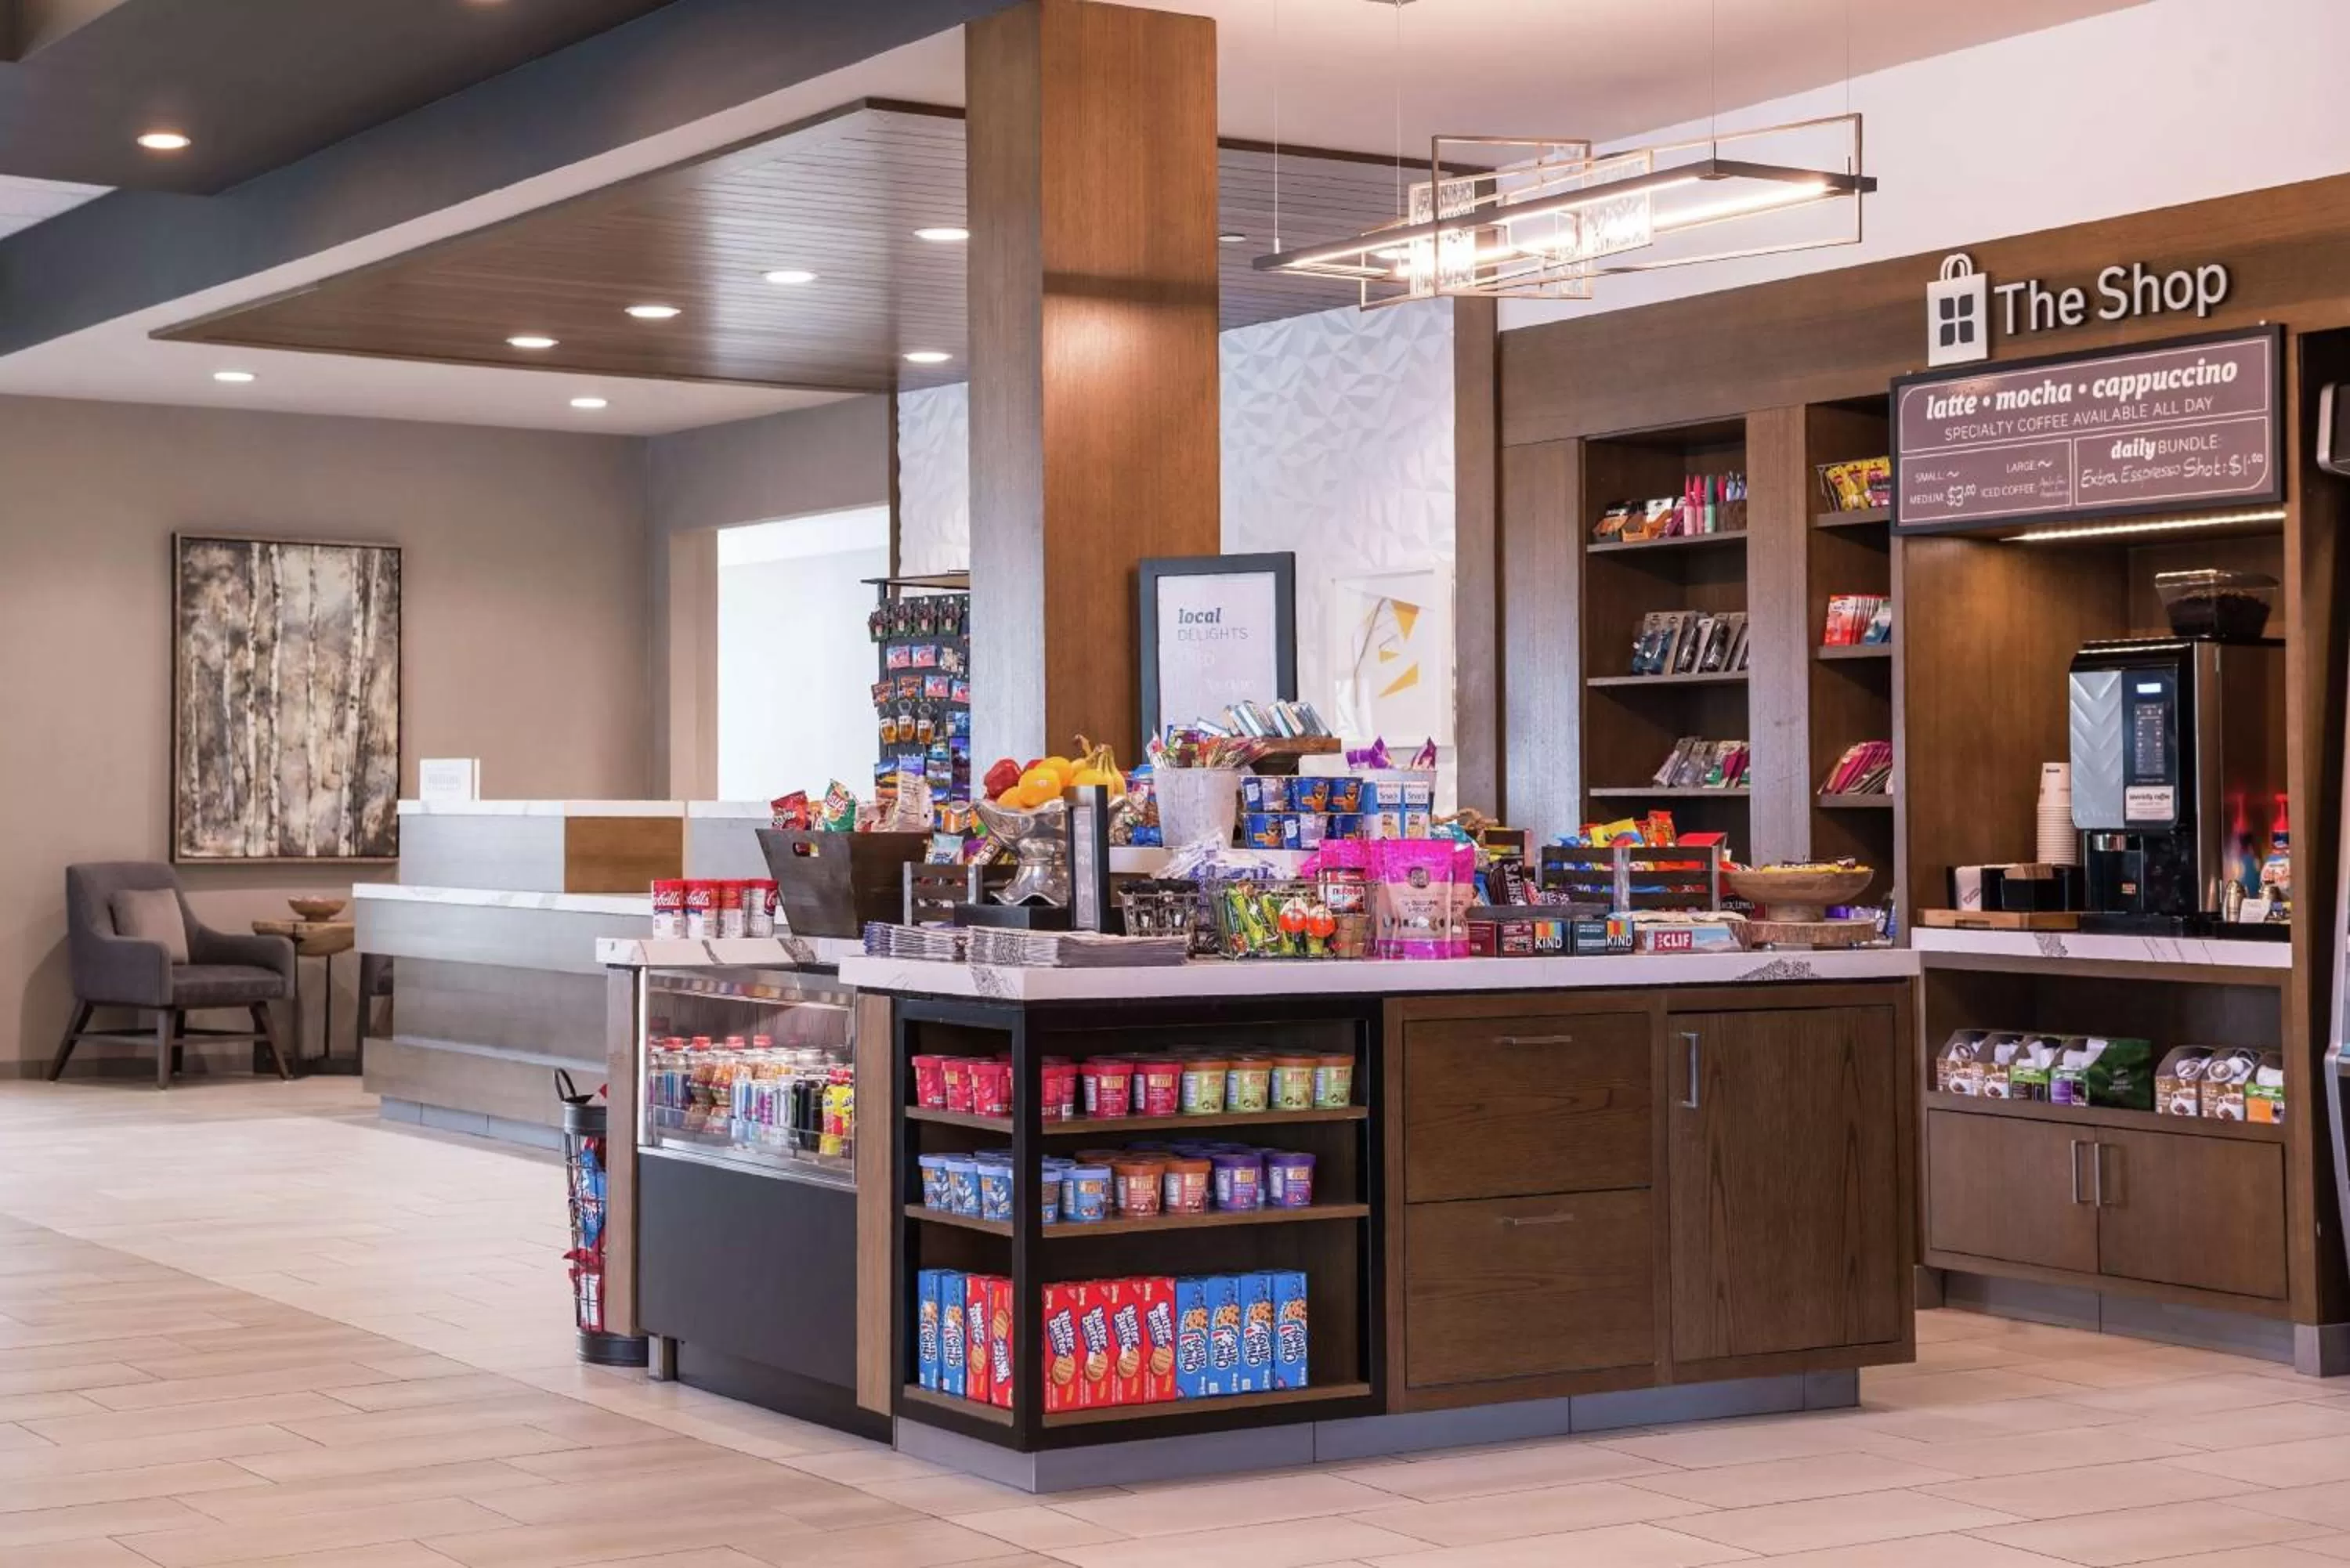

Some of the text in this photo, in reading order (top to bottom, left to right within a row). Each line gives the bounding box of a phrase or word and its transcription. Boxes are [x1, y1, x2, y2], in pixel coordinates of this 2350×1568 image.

[1994, 263, 2227, 335] The Shop
[1926, 358, 2238, 420] latte mocha cappuccino
[1944, 396, 2214, 441] SPECIALTY COFFEE AVAILABLE ALL DAY
[2110, 437, 2157, 461] daily
[1980, 486, 2001, 498] ICED
[2081, 468, 2118, 489] Extra
[1177, 607, 1221, 624] local
[1177, 627, 1249, 641] DELIGHTS
[1504, 863, 1522, 904] SHEY'S
[1535, 936, 1563, 949] KIND
[1607, 934, 1633, 948] KIND
[1662, 934, 1690, 948] CLIF
[1049, 1317, 1068, 1357] Butter
[1059, 1309, 1076, 1350] Nutter
[1082, 1315, 1101, 1354] Butter
[1091, 1306, 1108, 1348] Nutter
[1114, 1313, 1132, 1351] Butter
[1123, 1304, 1140, 1346] Nutter
[1148, 1310, 1166, 1348] Butter
[1158, 1302, 1173, 1342] Nutter
